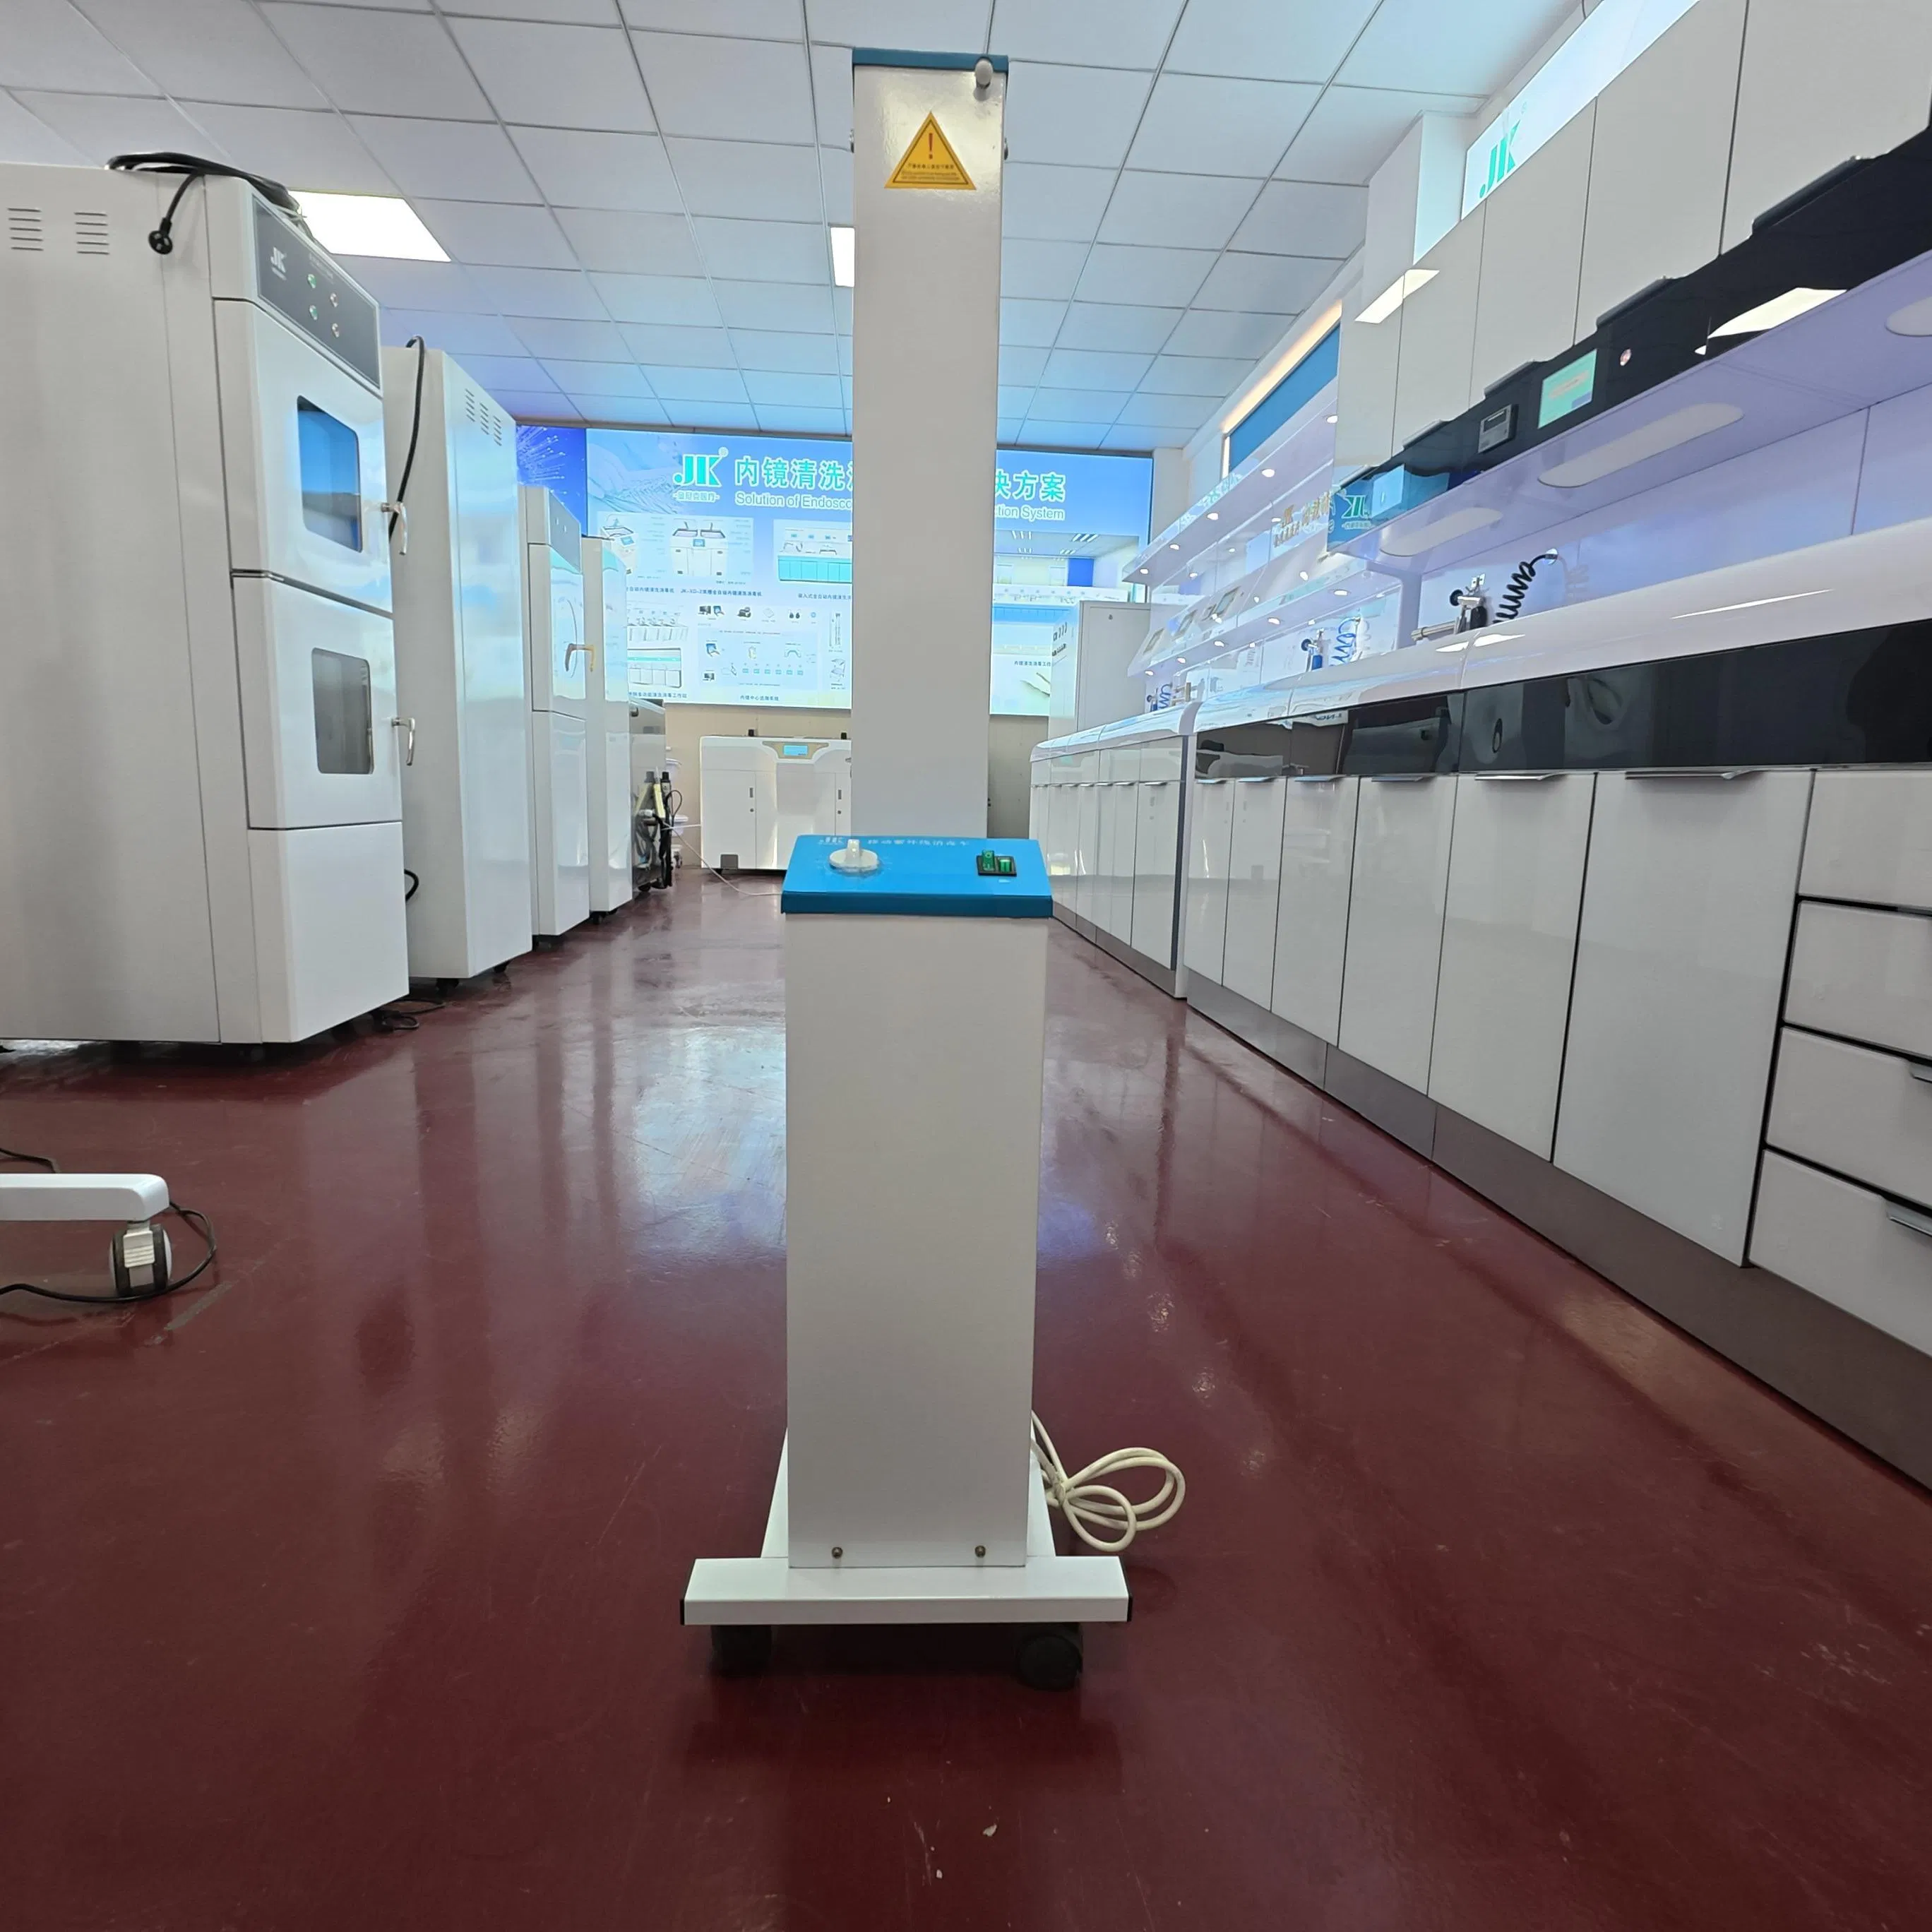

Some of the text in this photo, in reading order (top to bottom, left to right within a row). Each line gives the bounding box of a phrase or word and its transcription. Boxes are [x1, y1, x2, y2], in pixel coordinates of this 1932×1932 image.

[736, 456, 852, 489] 内镜清洗
[736, 493, 785, 506] Solution
[787, 495, 800, 506] of
[996, 506, 1018, 517] tion
[1022, 506, 1064, 520] System
